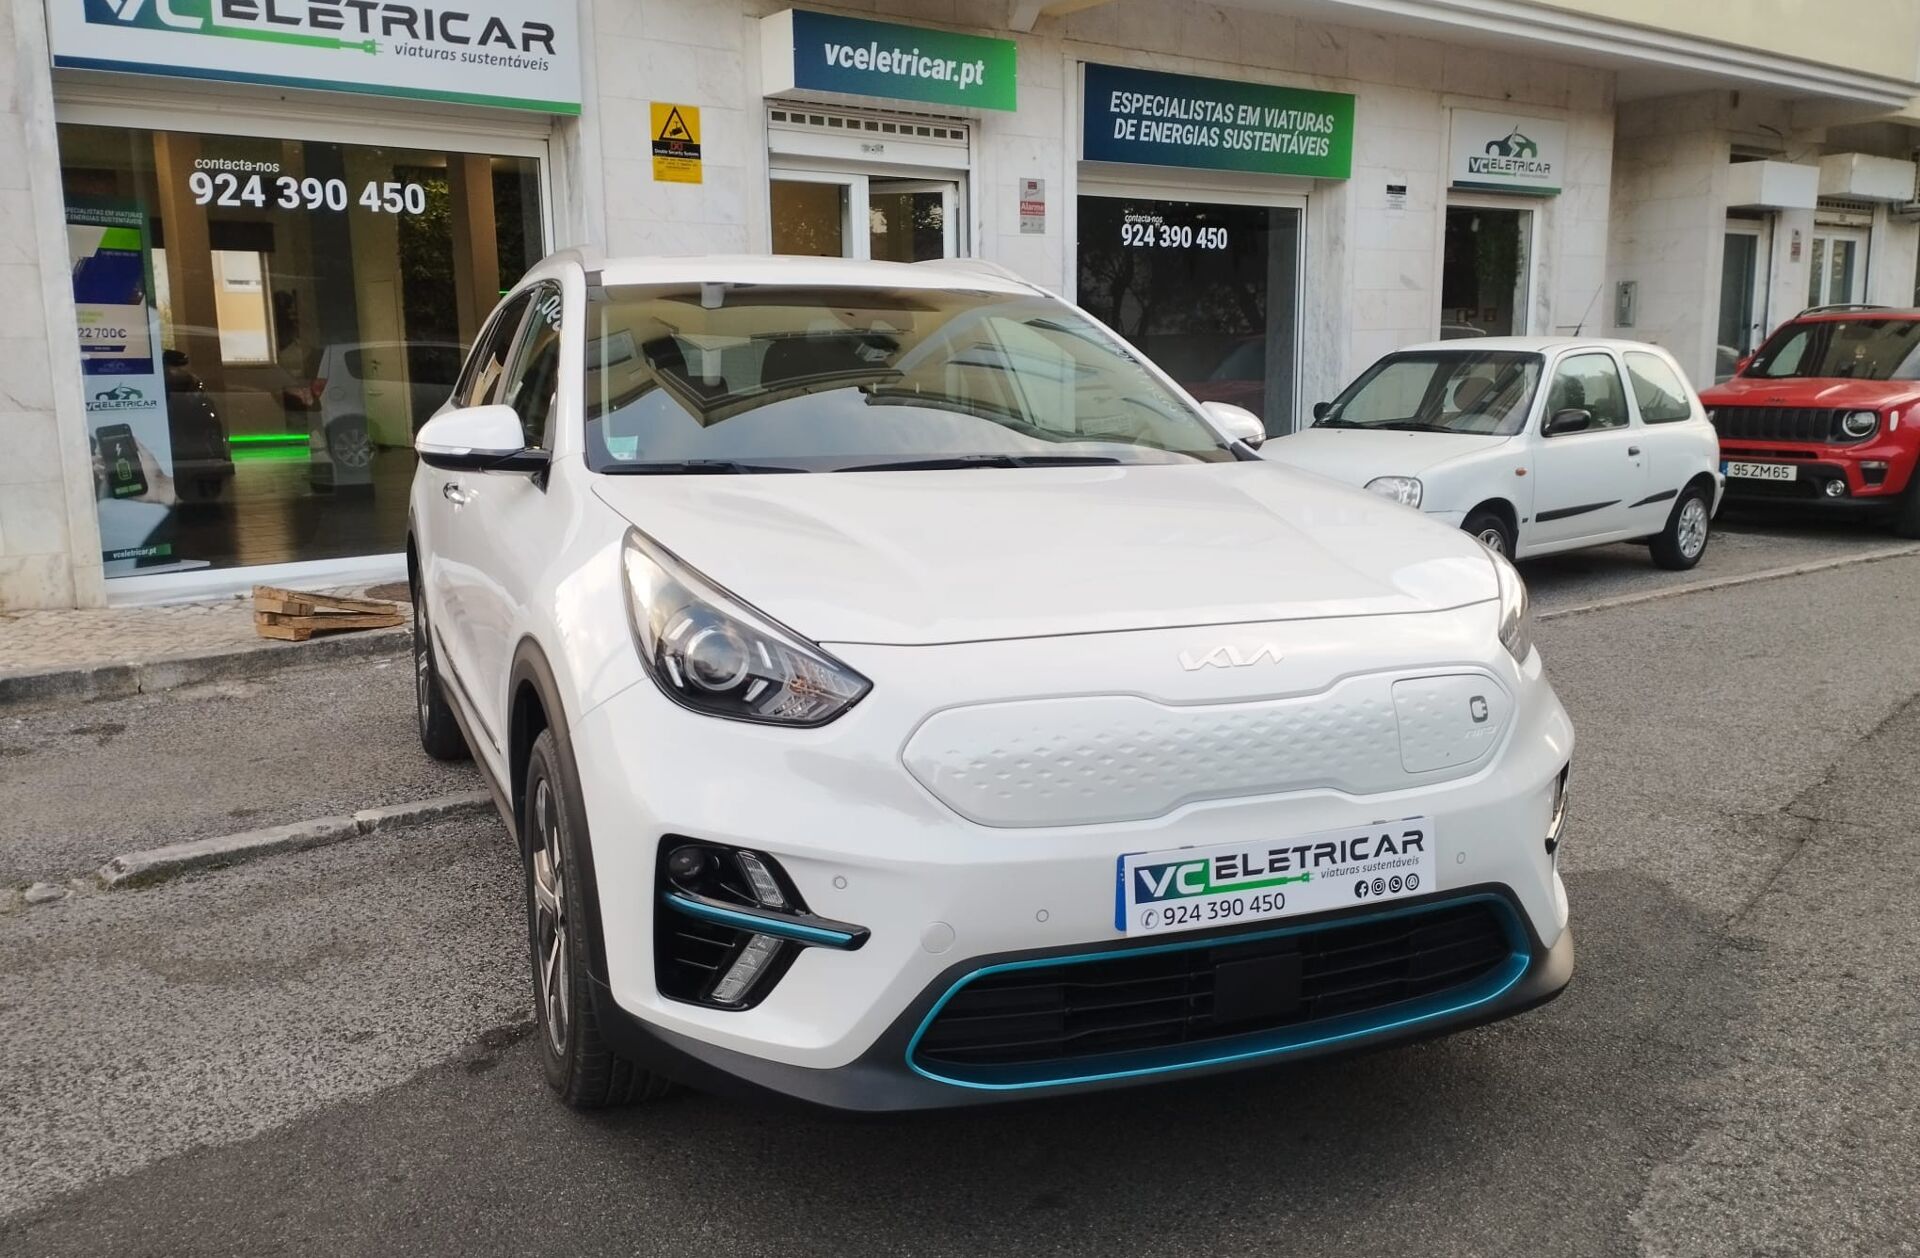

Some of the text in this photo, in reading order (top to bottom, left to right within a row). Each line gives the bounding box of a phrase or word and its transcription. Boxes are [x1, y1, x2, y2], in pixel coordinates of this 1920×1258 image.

[394, 42, 549, 71] viaturas sustentáveis
[824, 41, 985, 90] vceletricar.pt
[1110, 91, 1334, 134] ESPECIALISTAS EM VIATURAS
[1113, 118, 1330, 157] DE ENERGIAS SUSTENTÁVEIS
[194, 157, 280, 173] contacta-nos
[188, 171, 426, 215] 924 390 450
[1124, 213, 1163, 223] contacta-nos
[1121, 223, 1228, 249] 924 390 450
[78, 327, 92, 338] 22
[1732, 463, 1790, 479] 95 ZM 65
[1320, 855, 1420, 879] viaturas sustentáveis
[1163, 892, 1286, 927] 924 390 450
